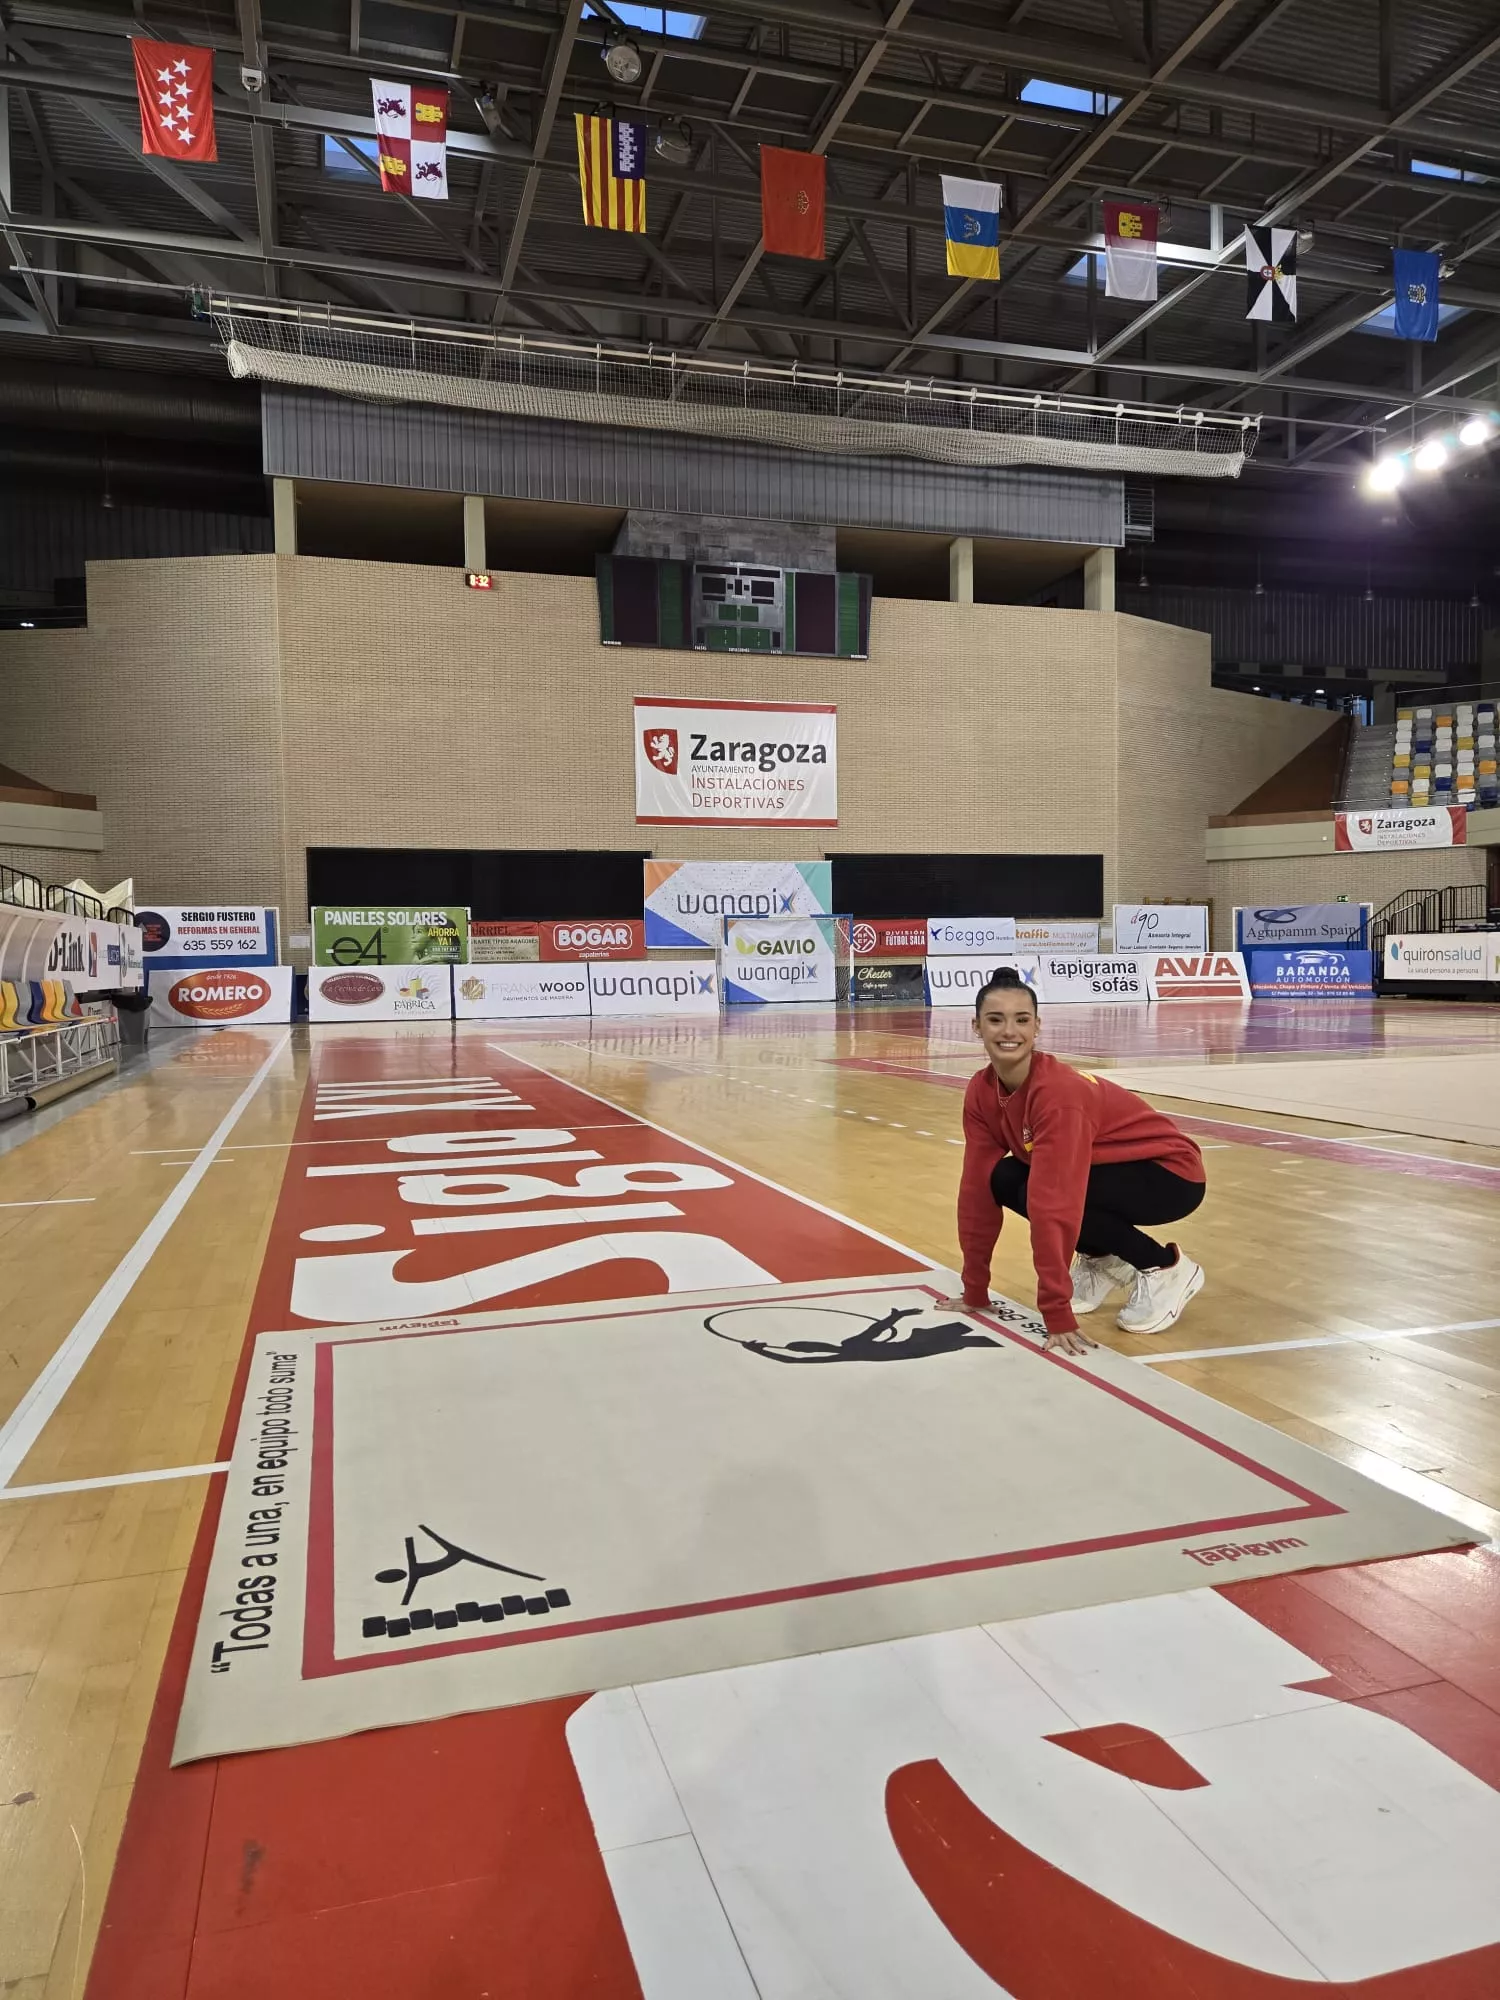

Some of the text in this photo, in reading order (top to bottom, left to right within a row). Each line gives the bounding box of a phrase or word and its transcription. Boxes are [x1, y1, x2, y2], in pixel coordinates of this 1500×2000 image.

[470, 574, 488, 587] 8:32
[690, 733, 827, 772] Zaragoza
[691, 764, 755, 774] AYUNTAMIENTO
[691, 774, 805, 792] INSTALACIONES
[692, 792, 784, 809] DEPORTIVAS
[1376, 818, 1436, 830] Zaragoza
[677, 888, 796, 917] wanapix
[181, 911, 256, 922] SERGIO FUSTERO
[324, 910, 448, 926] PANELES SOLARES
[178, 925, 261, 935] REFORMAS EN GENERAL
[428, 928, 460, 937] AHORRA
[558, 928, 628, 946] BOGAR
[945, 926, 995, 946] begga
[1016, 929, 1050, 938] traffic
[1246, 924, 1356, 940] Agrupamm Spain
[183, 939, 257, 950] 635 559 162
[756, 938, 816, 956] GAVIO
[910, 936, 925, 945] SALA
[48, 932, 85, 972] D-Link
[1404, 945, 1482, 965] quirónsalud
[737, 962, 818, 984] wanapix
[858, 967, 892, 980] Chester
[1050, 960, 1137, 978] tapigrama
[1276, 966, 1350, 976] BARANDA
[178, 984, 262, 1002] ROMERO
[594, 970, 714, 1001] wanapix
[1092, 976, 1138, 992] sofás
[314, 1077, 537, 1121] XXI
[290, 1128, 782, 1322] Siglo
[256, 1387, 294, 1416] todo
[250, 1418, 298, 1470] equipo
[250, 1474, 284, 1496] en
[245, 1501, 290, 1546] una,
[240, 1552, 278, 1567] a
[1182, 1535, 1309, 1566] tapigym
